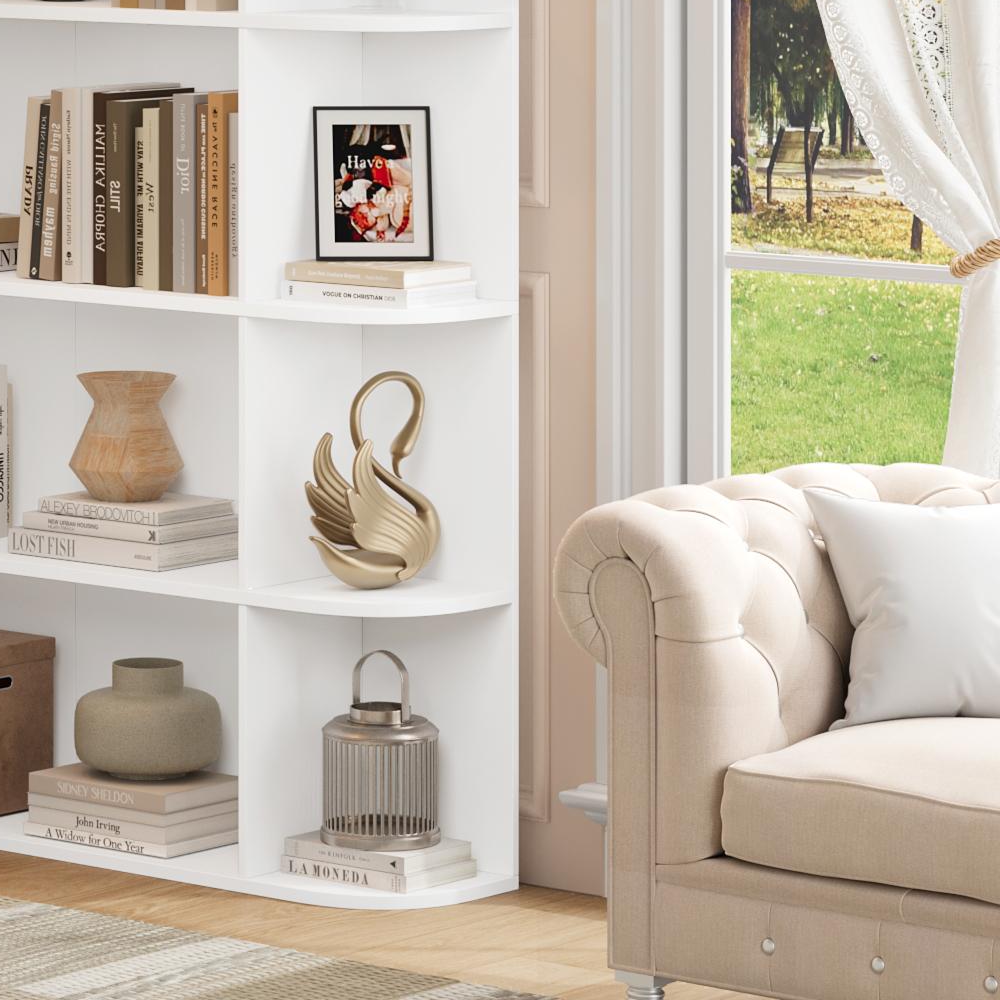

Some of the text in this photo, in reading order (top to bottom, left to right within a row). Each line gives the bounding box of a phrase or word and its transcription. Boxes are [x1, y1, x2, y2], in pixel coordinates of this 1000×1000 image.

[347, 155, 383, 169] Have
[353, 293, 383, 301] CHRISTIAN
[41, 500, 150, 524] ALEXEY BRODOVITCH
[76, 521, 98, 530] HOUSING
[12, 532, 75, 558] LOST FISH
[57, 782, 134, 805] SIDNEY SHELDON
[76, 816, 120, 834] John Irving
[45, 828, 144, 854] A Widow for One Year
[289, 860, 369, 886] LA MONEDA
